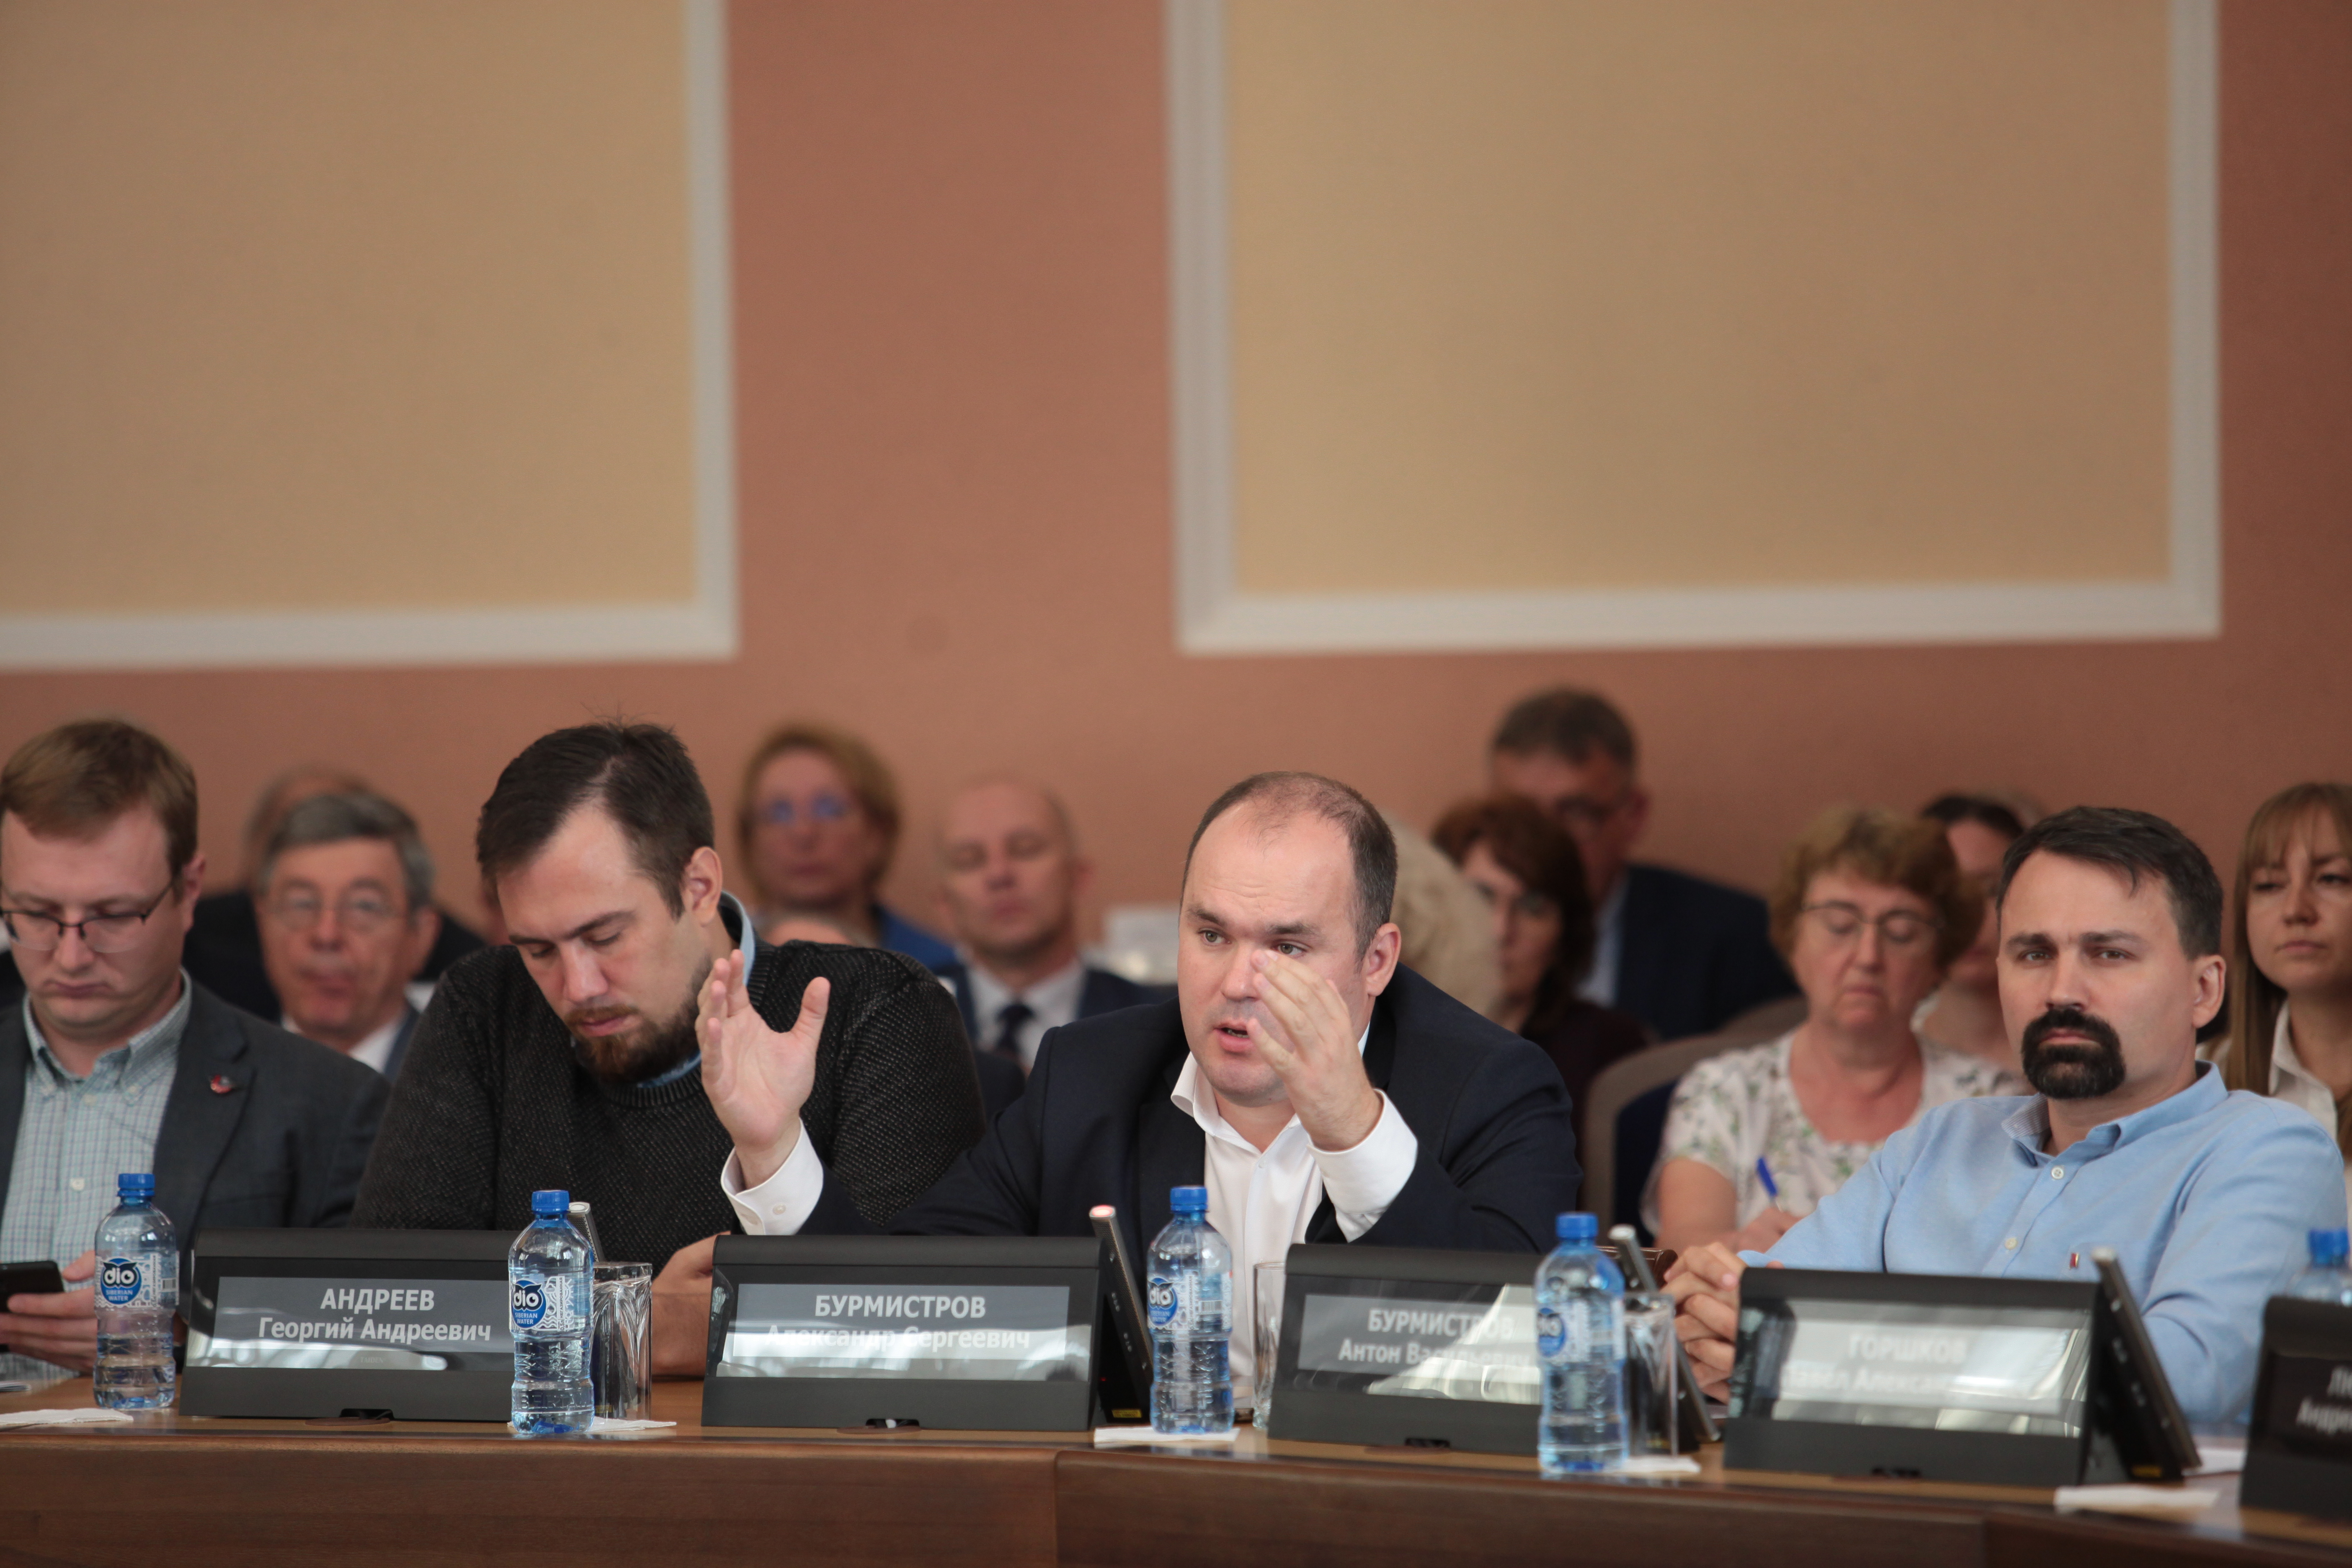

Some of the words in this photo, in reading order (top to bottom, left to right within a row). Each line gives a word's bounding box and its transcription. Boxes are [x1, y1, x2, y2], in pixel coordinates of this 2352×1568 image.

[104, 1267, 134, 1284] dio
[320, 1288, 434, 1314] АНДРЕЕВ
[514, 1290, 539, 1307] dio
[815, 1295, 986, 1318] БУРМИСТРОВ
[1150, 1287, 1171, 1305] dio
[259, 1317, 353, 1343] Георгий
[360, 1319, 491, 1344] Андреевич
[903, 1326, 1030, 1353] Сергеевич
[1338, 1338, 1400, 1364] Антон
